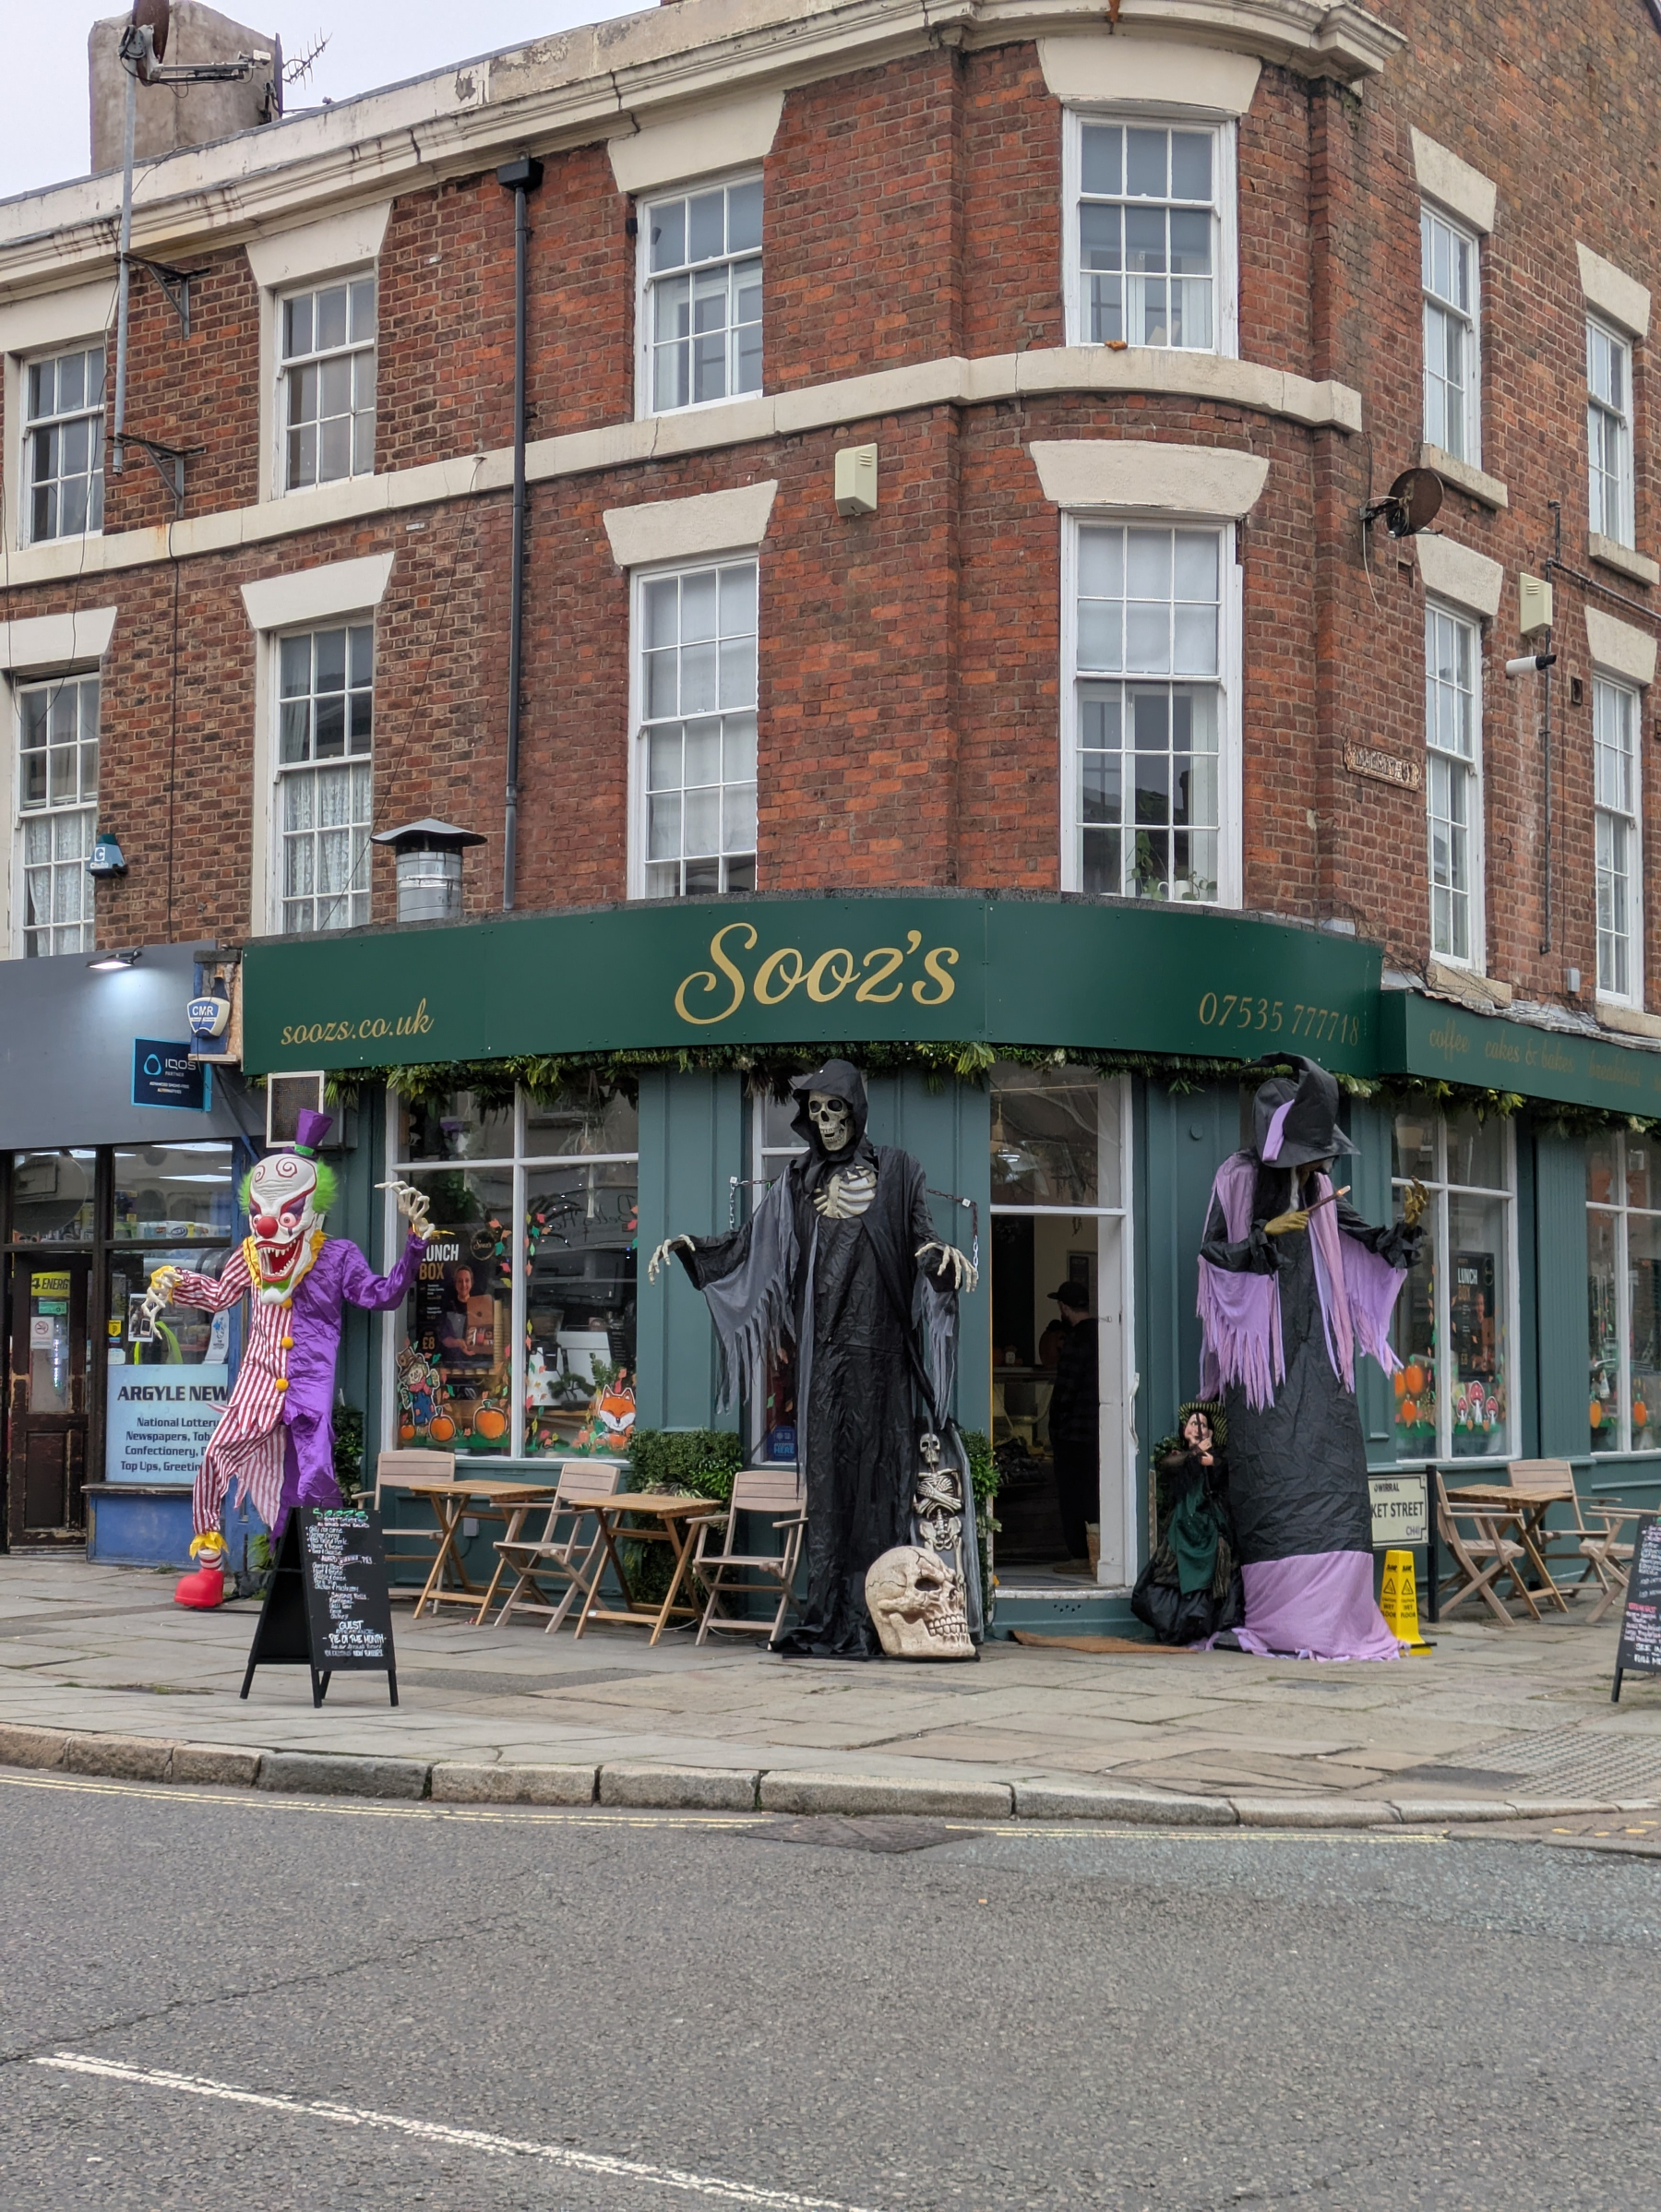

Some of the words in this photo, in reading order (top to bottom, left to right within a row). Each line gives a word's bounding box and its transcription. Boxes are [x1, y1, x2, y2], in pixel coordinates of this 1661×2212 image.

[675, 922, 960, 1024] Sooz's
[192, 1005, 214, 1016] CMR
[281, 997, 435, 1046] soozs.co.uk
[1199, 992, 1283, 1033] 07535
[1291, 1004, 1359, 1046] 777718
[1429, 1017, 1470, 1062] coffee
[1485, 1030, 1520, 1063] cakes
[1525, 1038, 1538, 1067] &
[1541, 1039, 1574, 1073] bakes
[165, 1058, 197, 1070] IQOS
[419, 1262, 445, 1280] BOX
[1458, 1267, 1478, 1285] LUNCH
[422, 1337, 436, 1349] £8
[117, 1386, 185, 1401] ARGYLE
[137, 1417, 179, 1427] National
[125, 1431, 191, 1442] Newspapers,
[125, 1445, 198, 1458] Confectionery,
[121, 1461, 137, 1472] Top
[139, 1461, 161, 1473] Ups,
[1379, 1482, 1400, 1492] WIRRAL
[1391, 1501, 1424, 1517] STREET
